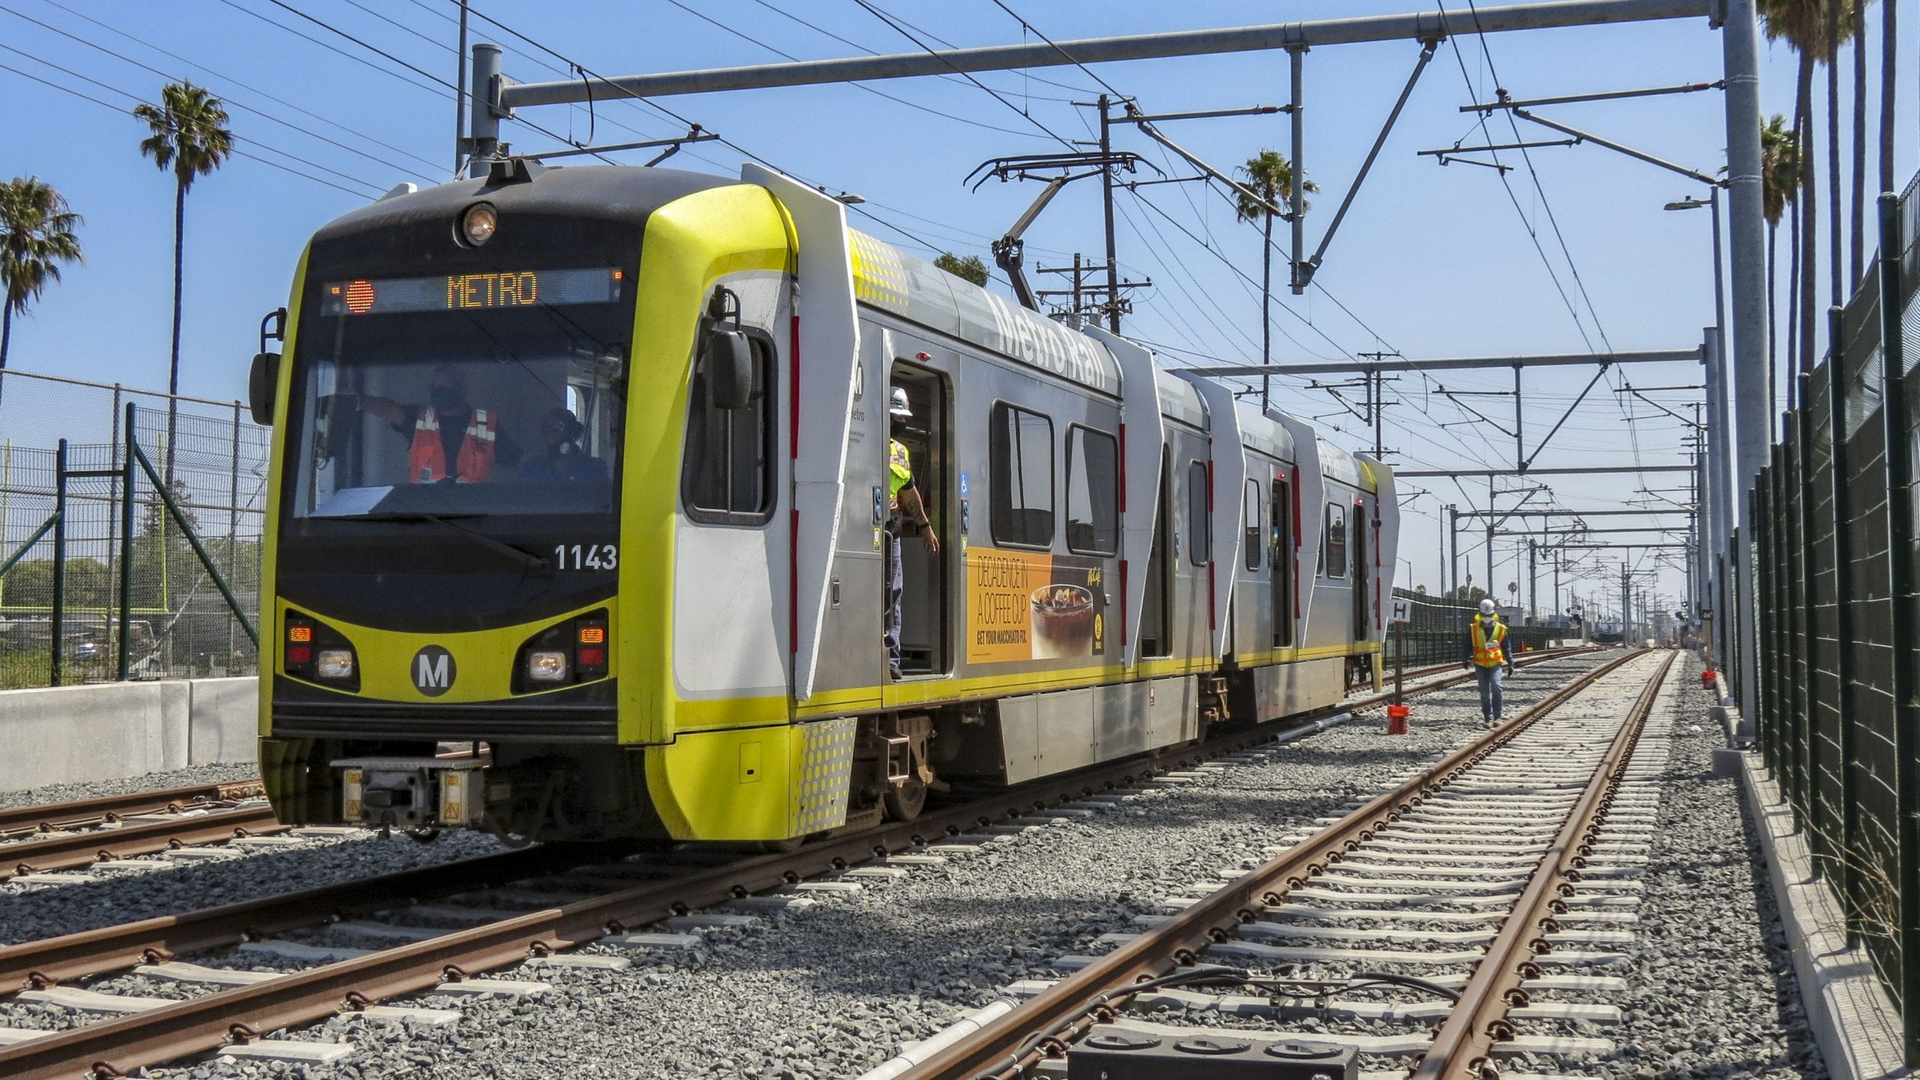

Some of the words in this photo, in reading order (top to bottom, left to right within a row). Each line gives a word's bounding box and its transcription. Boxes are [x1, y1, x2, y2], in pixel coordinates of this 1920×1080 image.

[447, 272, 537, 309] METRO
[852, 408, 865, 421] etro
[555, 544, 617, 570] 1143
[978, 555, 1020, 589] DECADENCE
[1021, 558, 1029, 589] IN
[977, 592, 984, 624] A
[984, 592, 1011, 624] COFFEE
[1012, 593, 1026, 624] CUP
[1393, 602, 1406, 619] H
[418, 654, 448, 688] M
